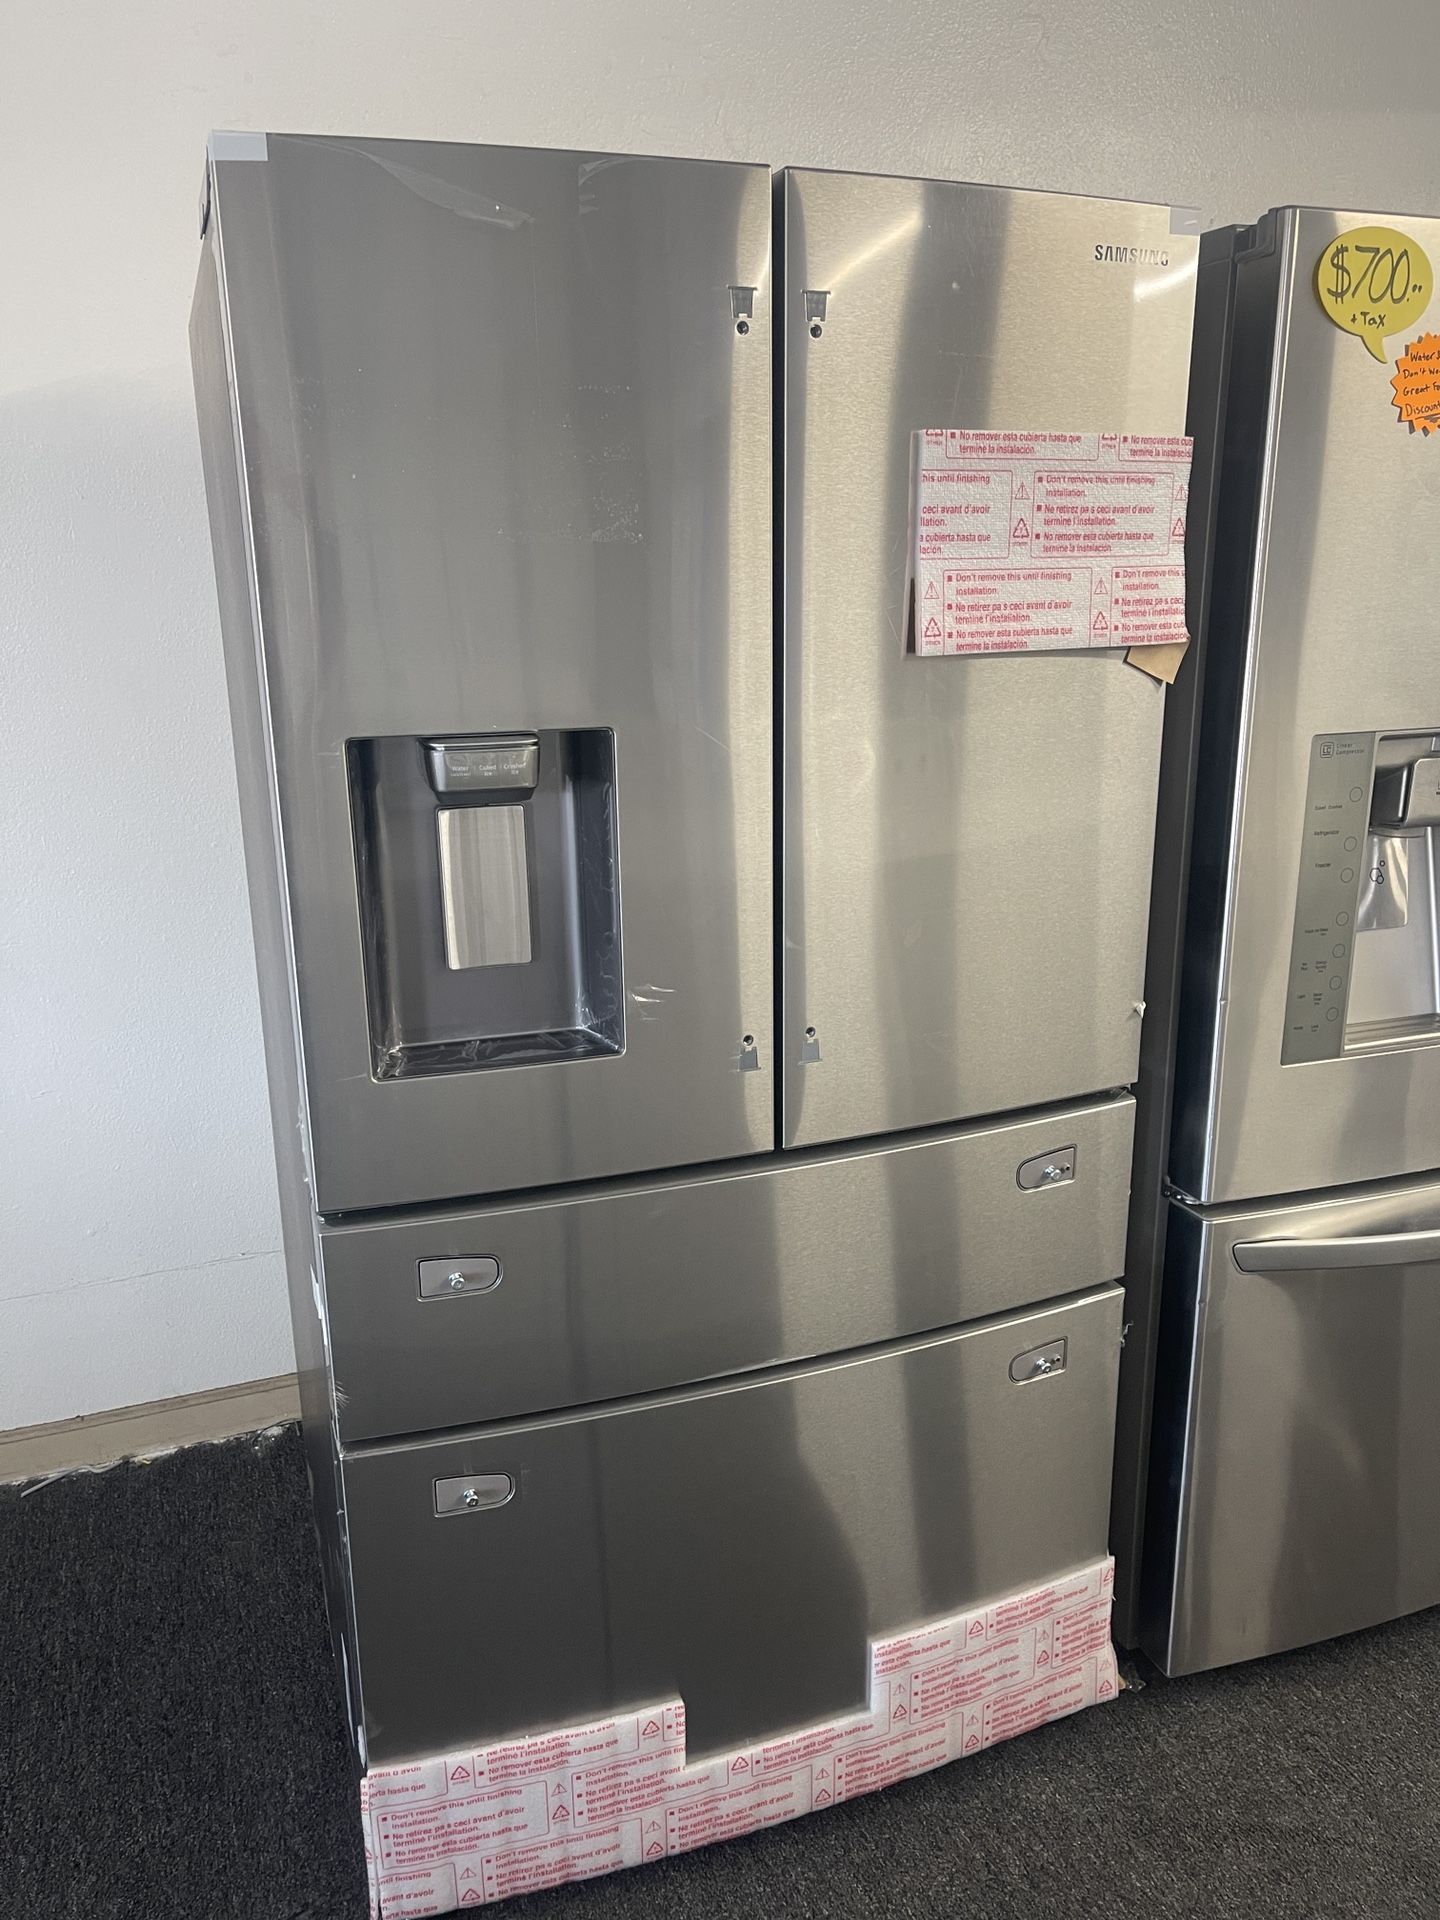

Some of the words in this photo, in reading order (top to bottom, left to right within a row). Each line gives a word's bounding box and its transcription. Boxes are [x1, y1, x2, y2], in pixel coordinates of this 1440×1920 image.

[1094, 244, 1169, 266] SAMSUNG
[1360, 311, 1387, 329] Tax
[1410, 350, 1436, 362] Water
[1402, 367, 1426, 379] Don't
[1403, 384, 1431, 396] Great
